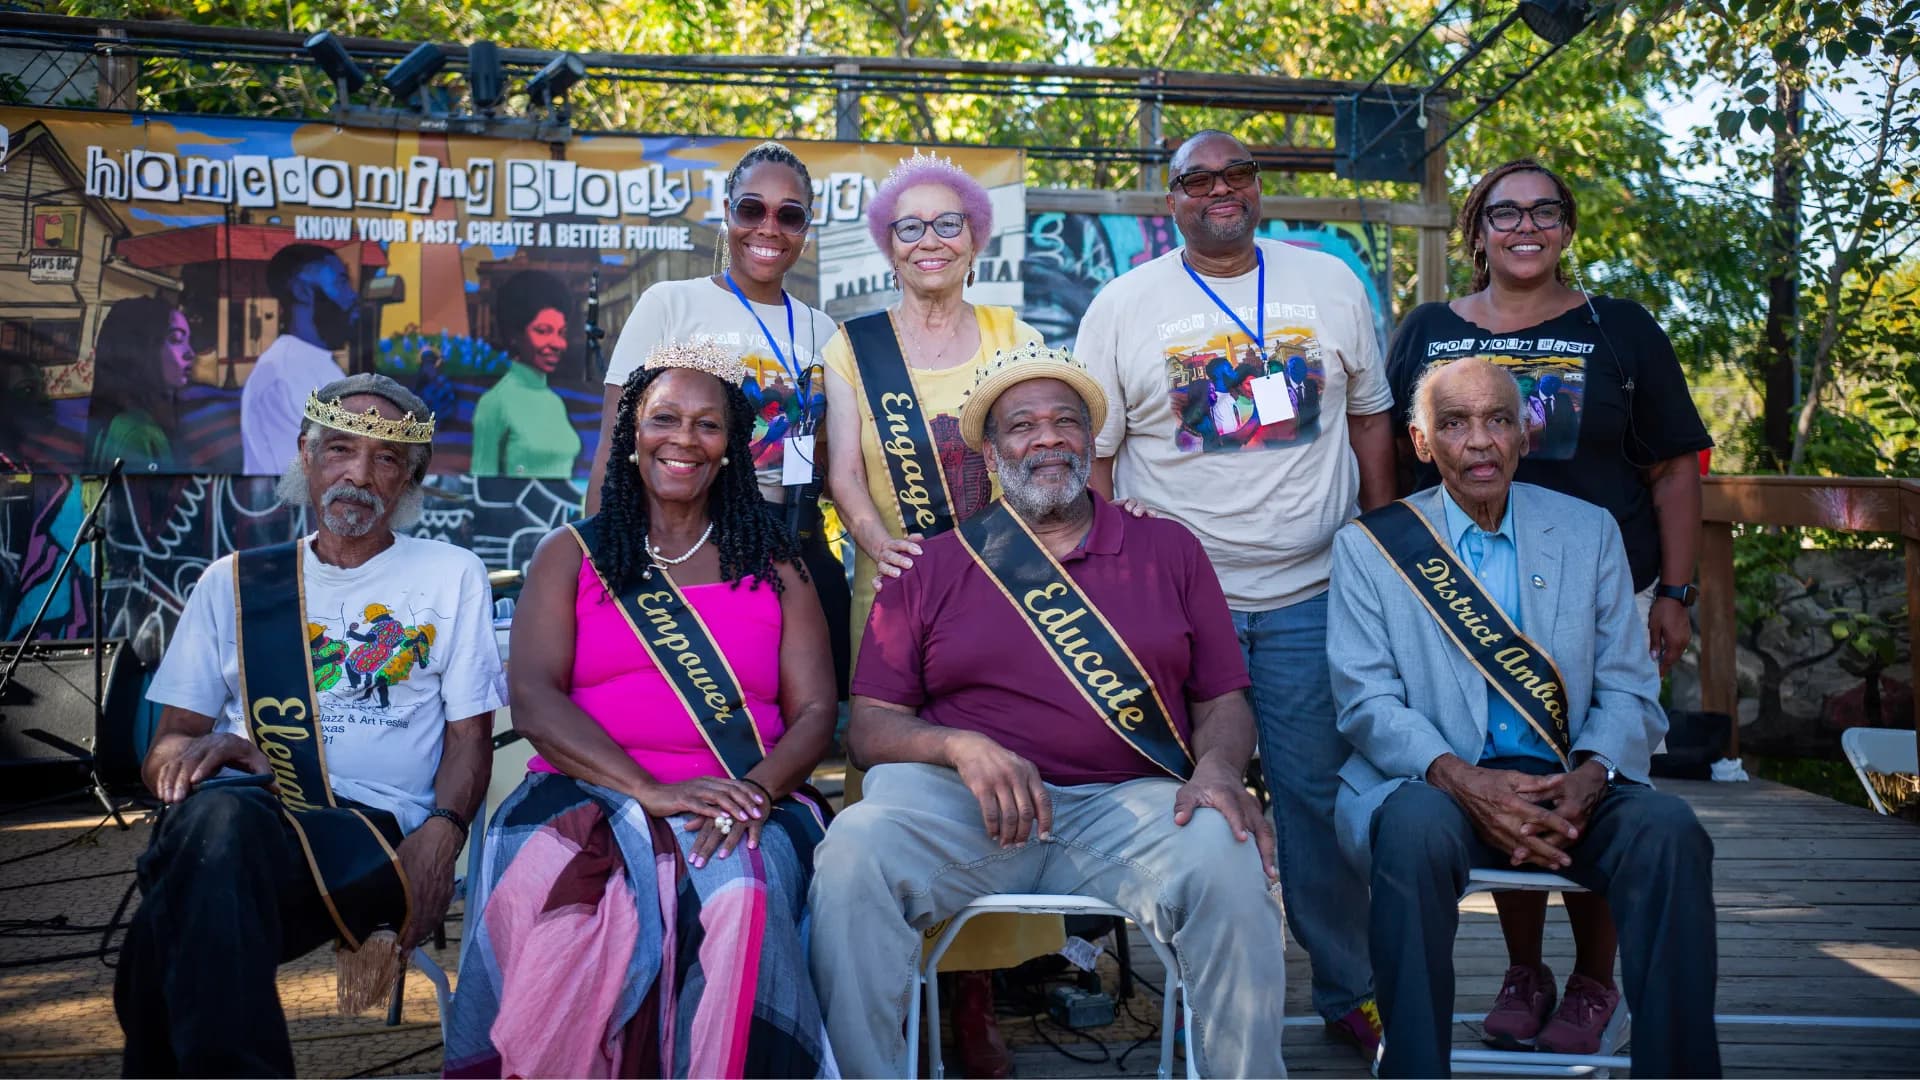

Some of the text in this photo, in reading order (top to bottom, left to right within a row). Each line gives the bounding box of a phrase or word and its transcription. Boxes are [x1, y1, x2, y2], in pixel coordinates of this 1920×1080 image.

[295, 215, 695, 250] KNOW YOUR PAST. CREATE A BETTER FUTURE.
[1427, 338, 1476, 357] Know
[1479, 337, 1534, 351] your
[881, 392, 936, 529] Engage
[1416, 558, 1504, 648] District
[637, 590, 734, 725] Empower
[1023, 582, 1145, 731] Educate
[360, 715, 375, 726] Art
